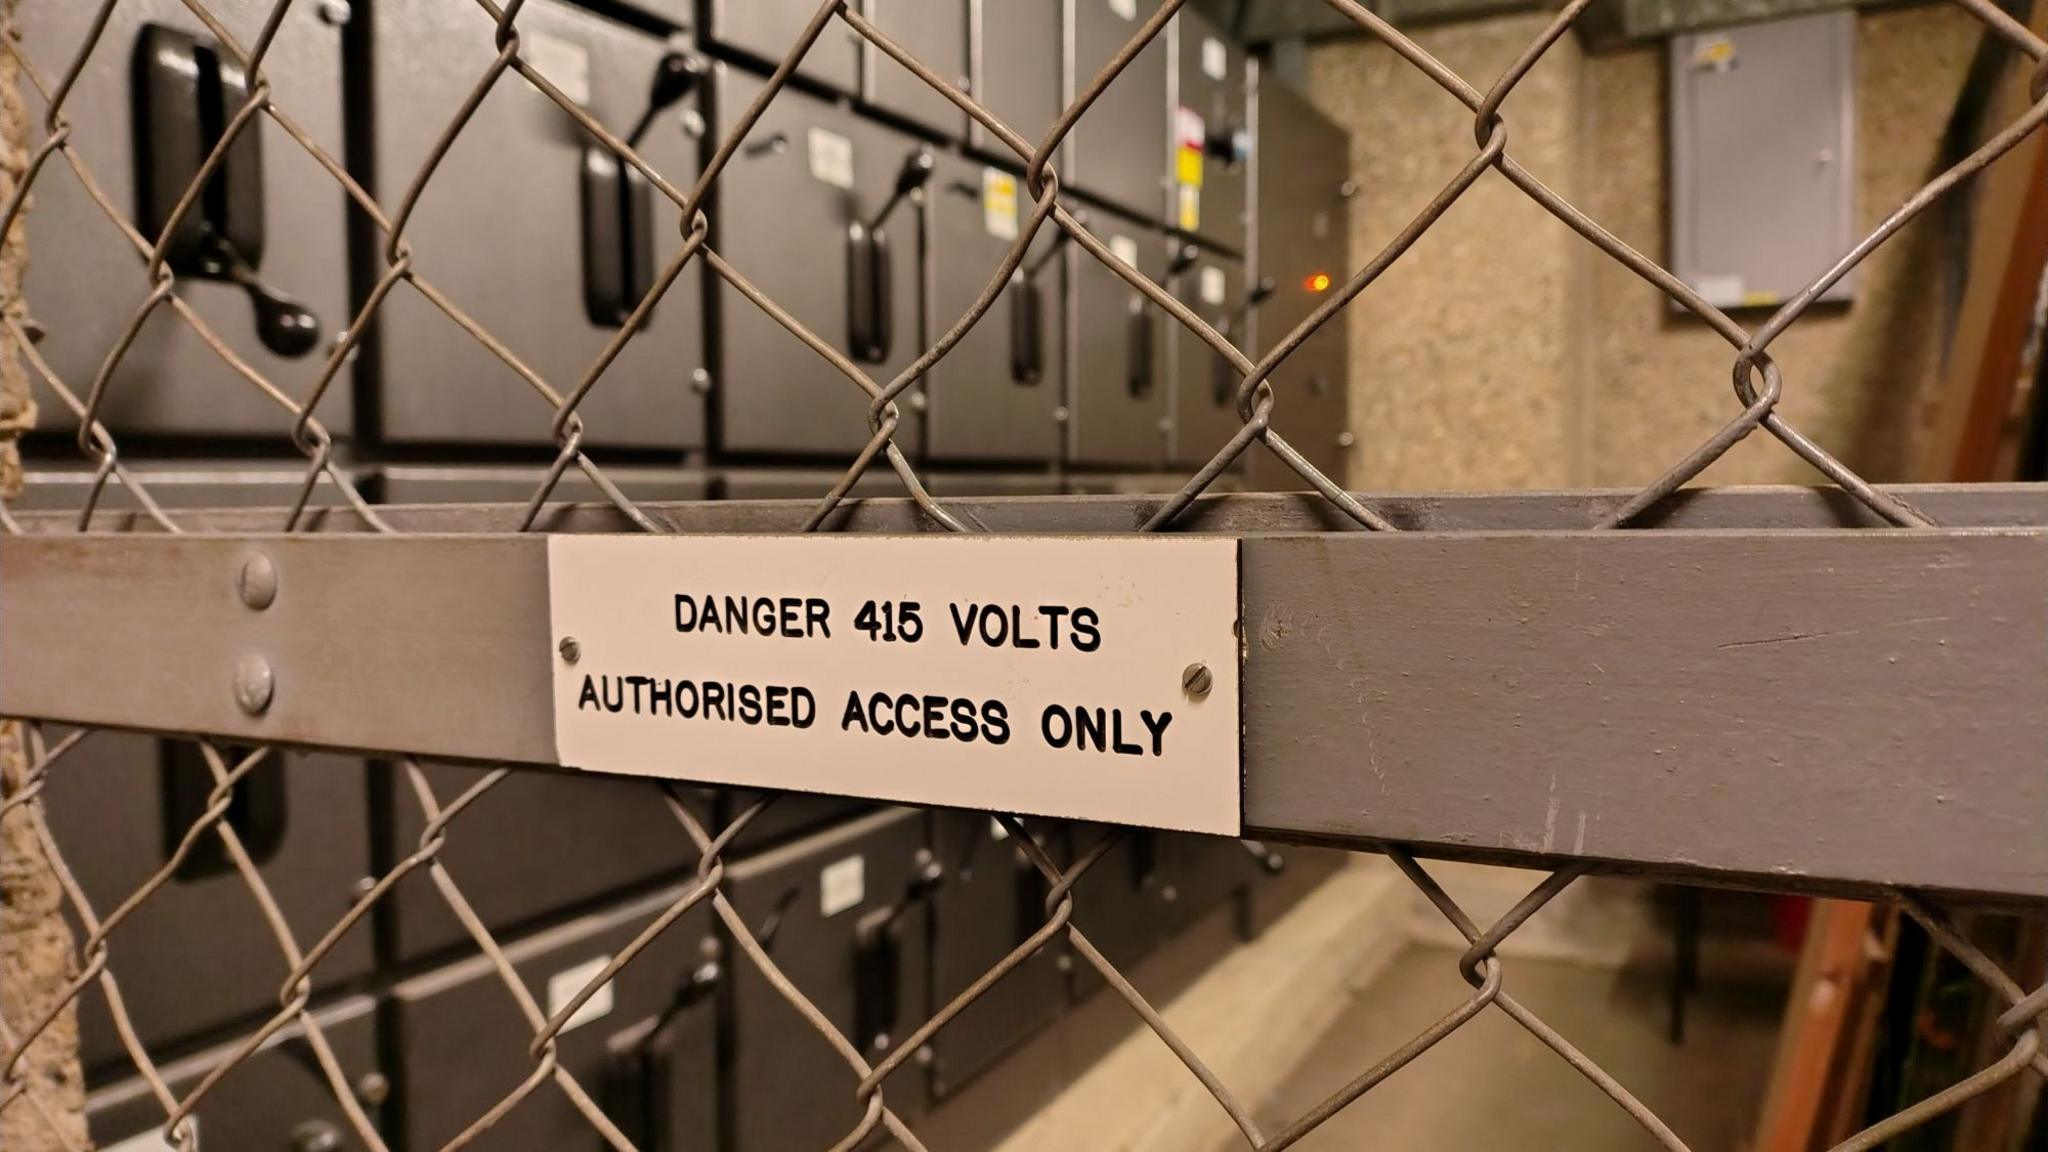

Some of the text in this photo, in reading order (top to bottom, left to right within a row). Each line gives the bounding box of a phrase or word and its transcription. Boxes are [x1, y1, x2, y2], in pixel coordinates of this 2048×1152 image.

[674, 593, 1102, 653] DANGER 415 VOLTS
[578, 674, 1173, 757] AUTHORISED ACCESS ONLY
